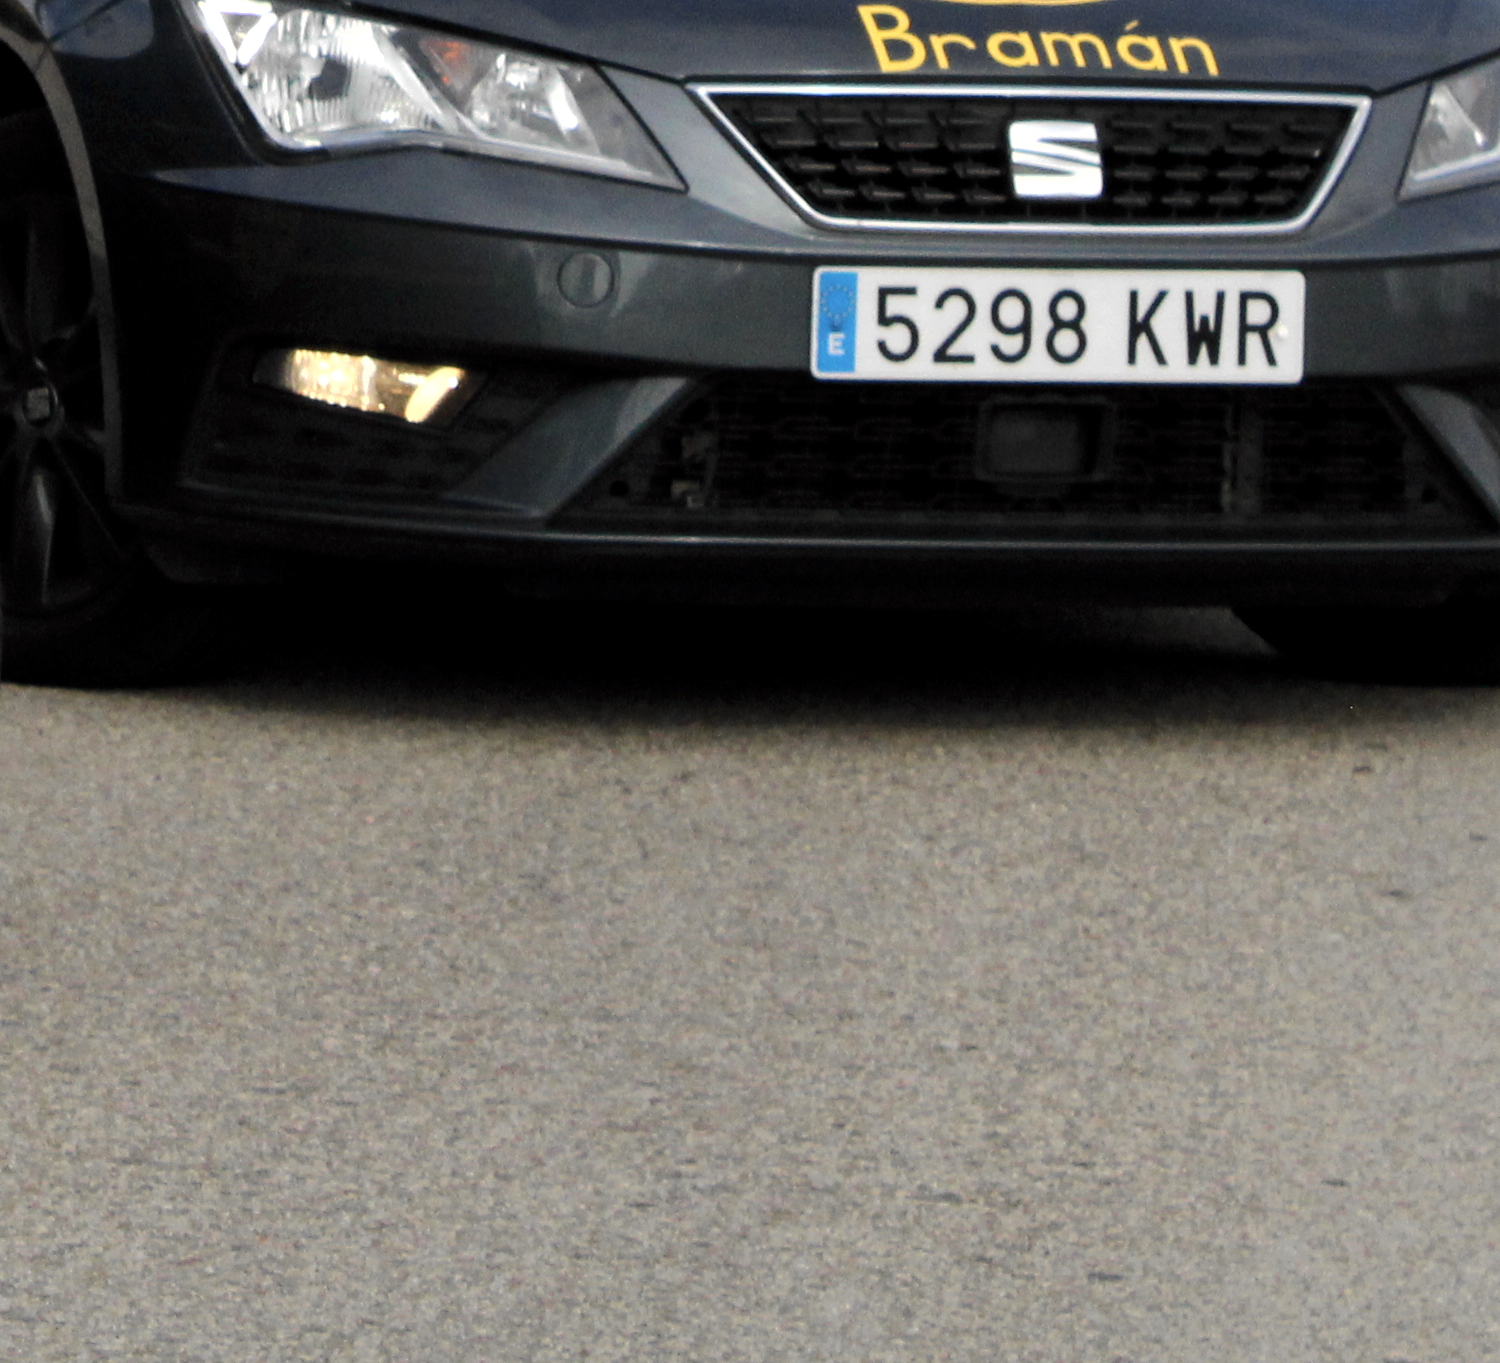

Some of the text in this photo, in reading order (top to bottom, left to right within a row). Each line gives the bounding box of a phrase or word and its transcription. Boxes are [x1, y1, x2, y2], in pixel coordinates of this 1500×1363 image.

[857, 4, 1219, 76] Bramán
[827, 333, 845, 355] E
[876, 286, 1281, 366] 5298 KWR
